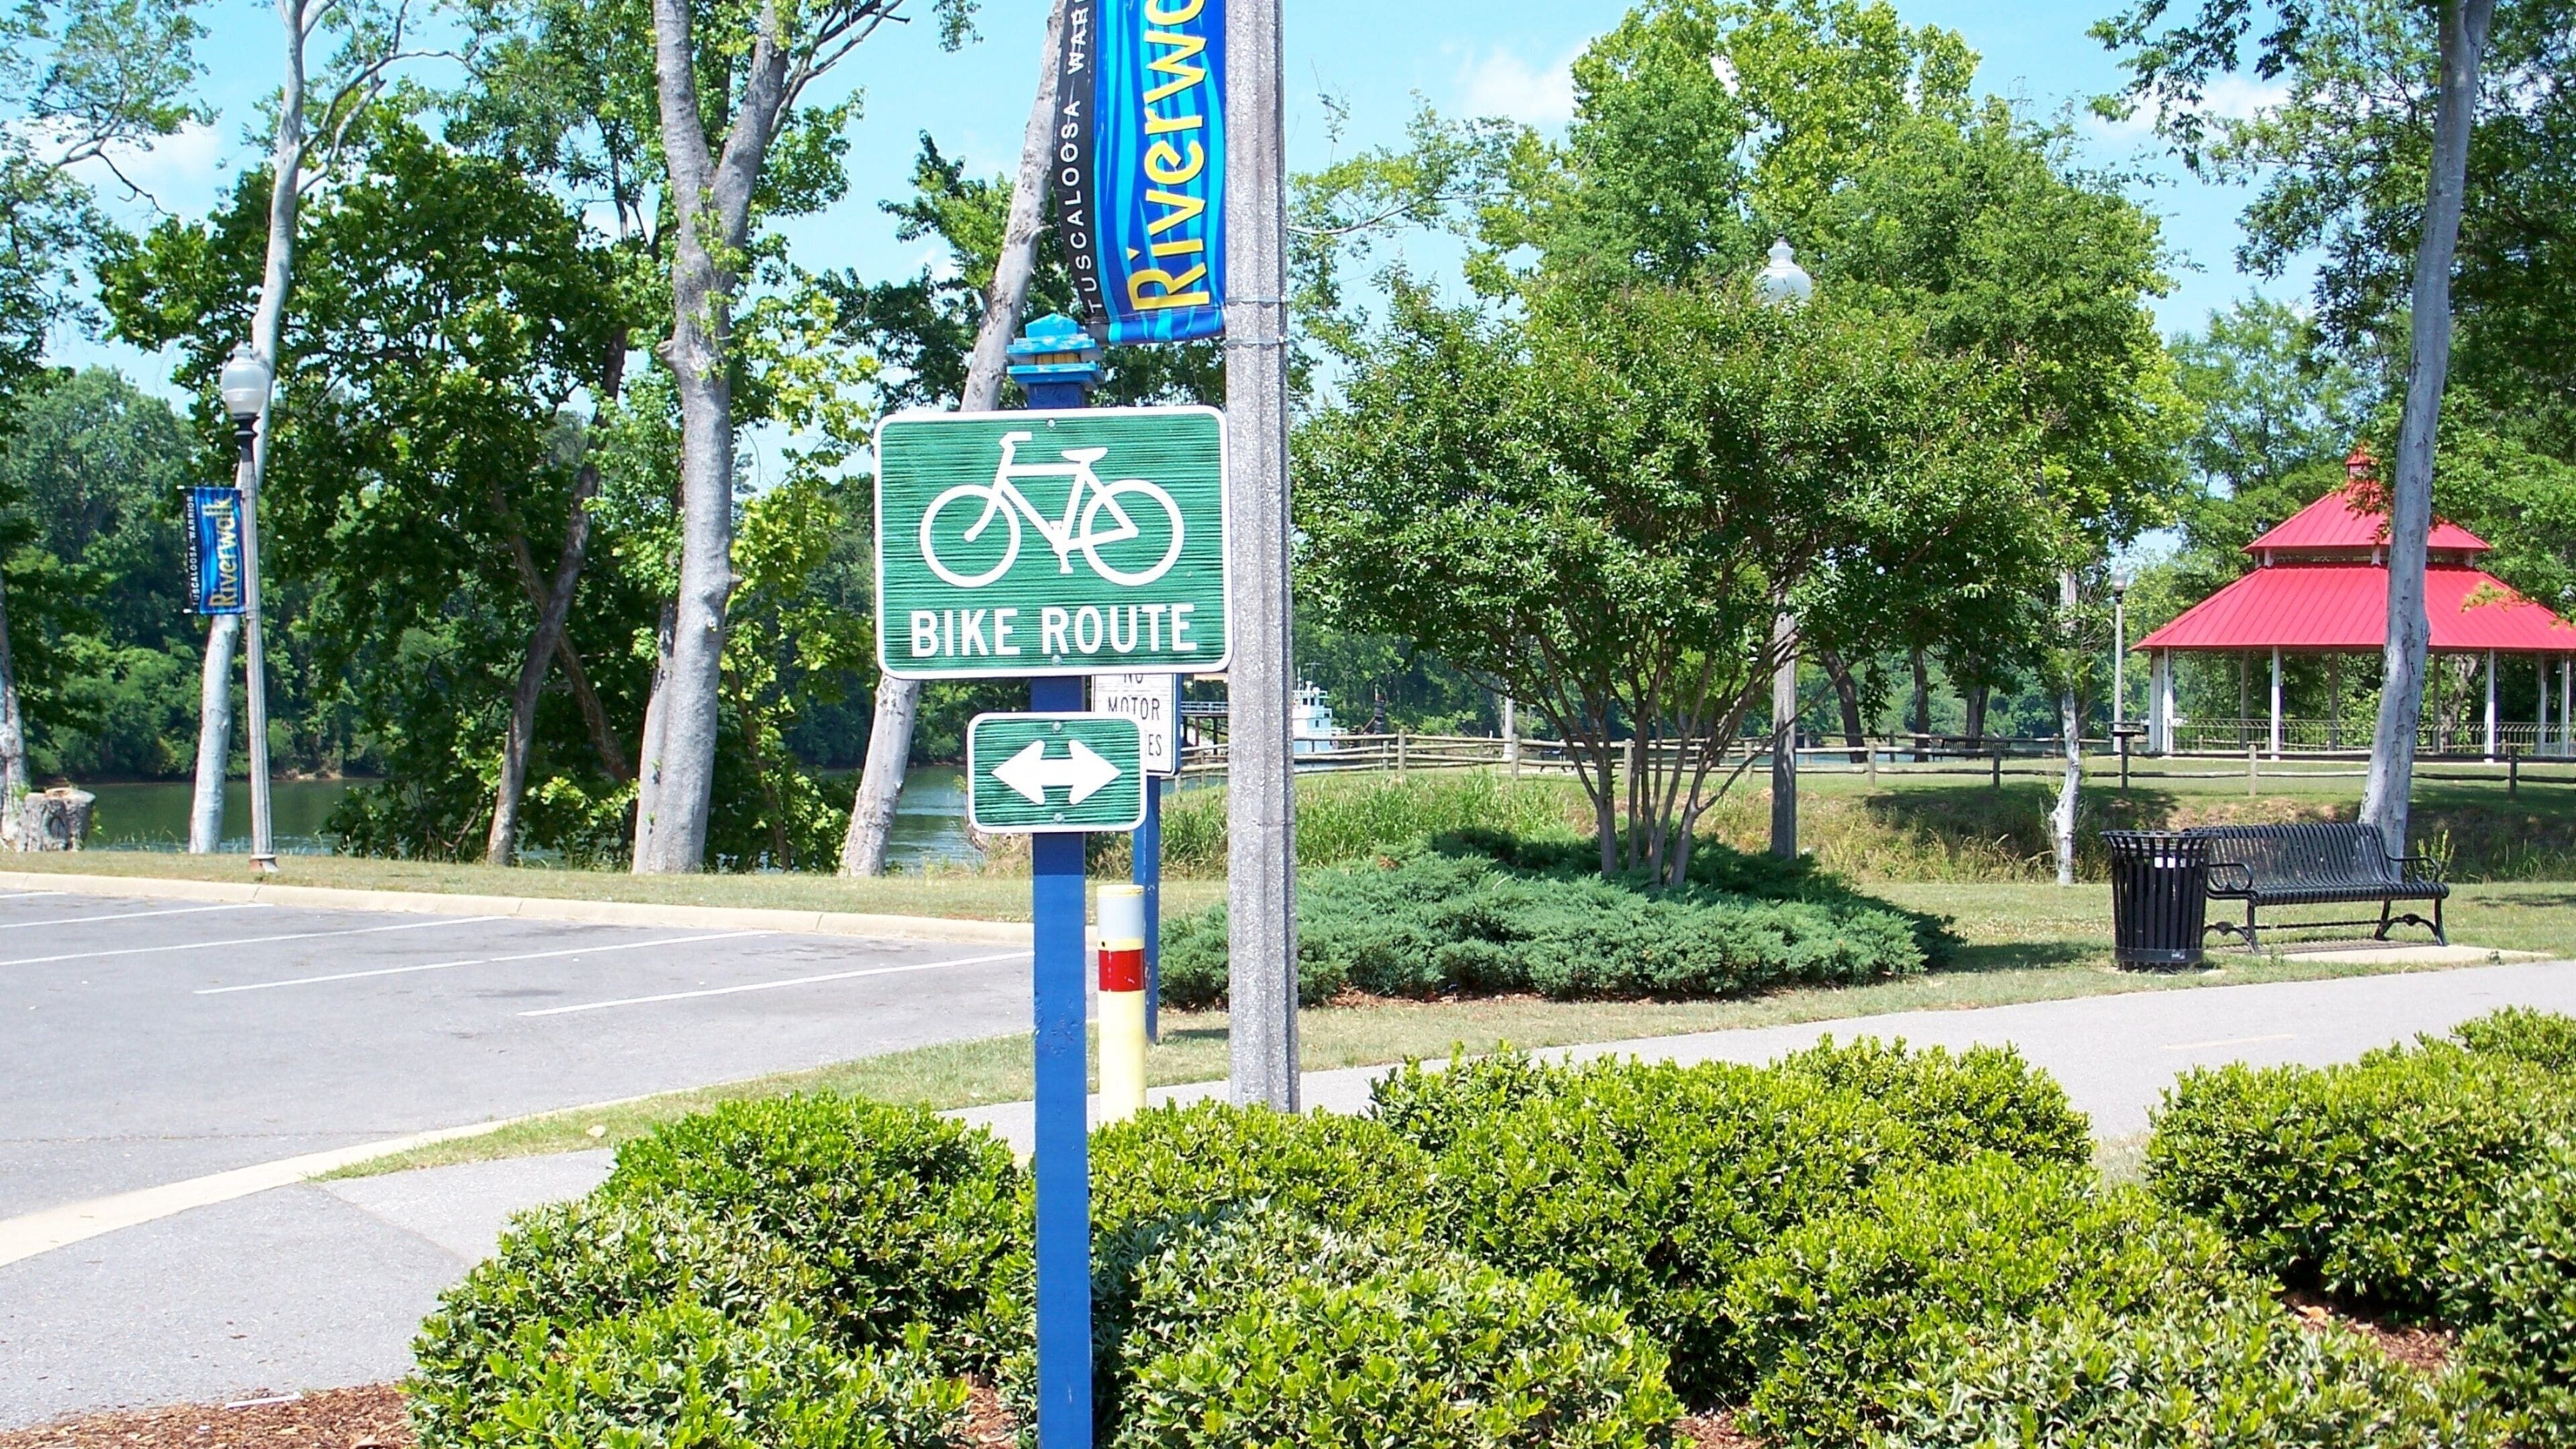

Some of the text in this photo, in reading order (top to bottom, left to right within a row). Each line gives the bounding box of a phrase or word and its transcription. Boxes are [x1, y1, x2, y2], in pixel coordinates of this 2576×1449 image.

[1061, 0, 1103, 313] TUSCALOOSA WAR
[186, 496, 200, 606] TUSCALOOSA WARRIOR
[202, 495, 237, 606] Riverwalk
[910, 604, 1197, 657] BIKE ROUTE
[1108, 696, 1160, 720] MOTOR
